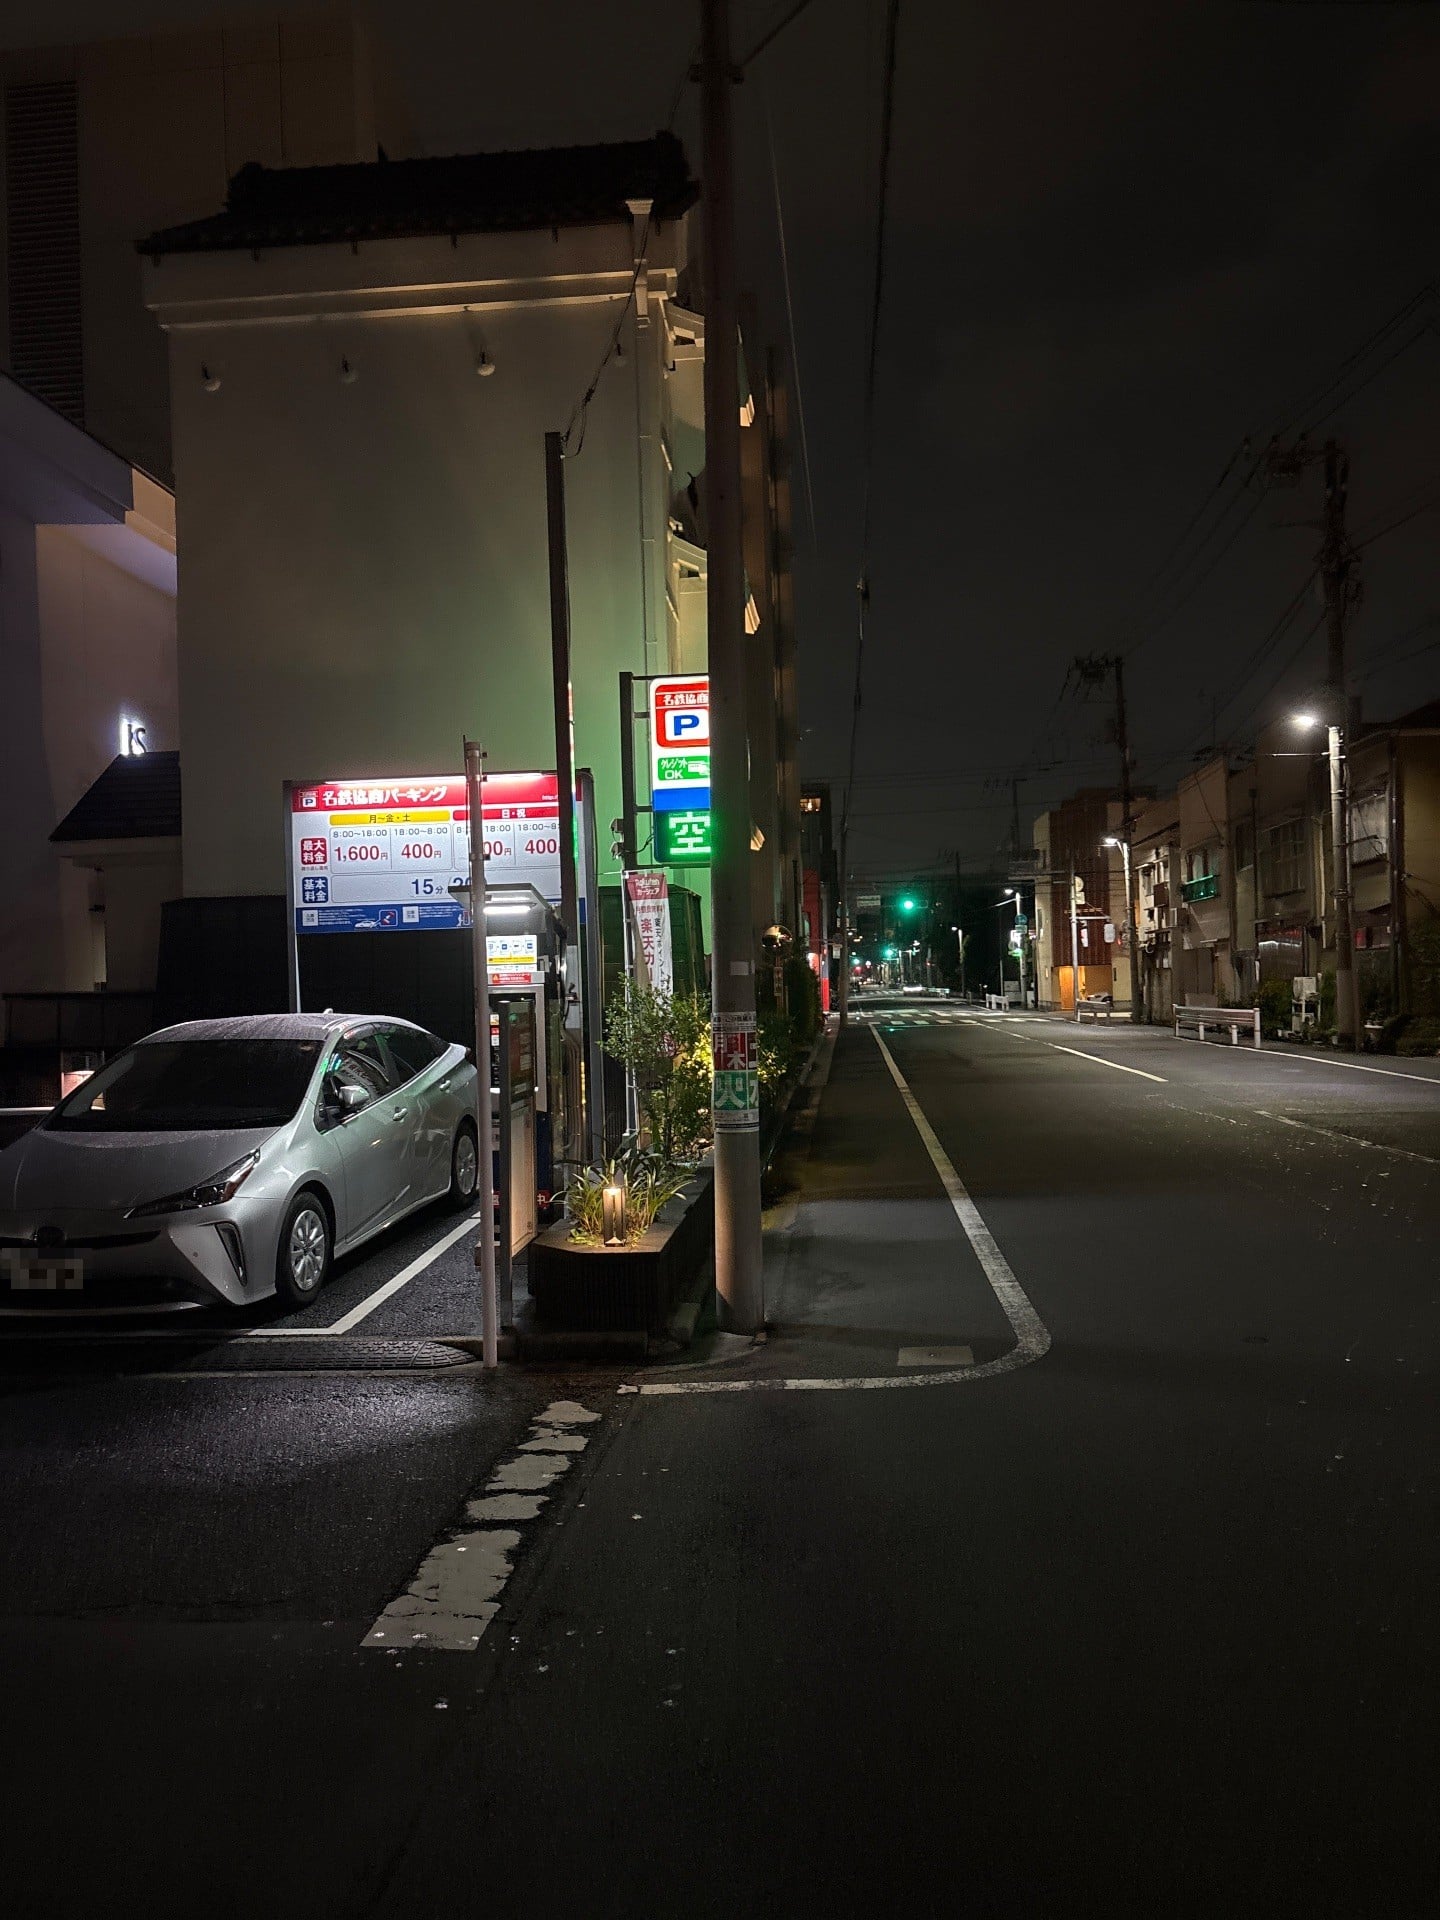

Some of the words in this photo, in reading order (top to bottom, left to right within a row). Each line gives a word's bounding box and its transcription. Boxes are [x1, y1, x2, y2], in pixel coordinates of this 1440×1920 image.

[673, 714, 700, 736] P
[664, 769, 684, 780] OK
[322, 785, 448, 807] 名鉄協商パーキング
[668, 811, 711, 855] 空
[303, 840, 326, 851] 最大
[401, 843, 442, 859] 400円
[524, 838, 560, 854] 400
[303, 852, 326, 863] 料金
[304, 879, 326, 890] 基本
[304, 891, 326, 902] 料金
